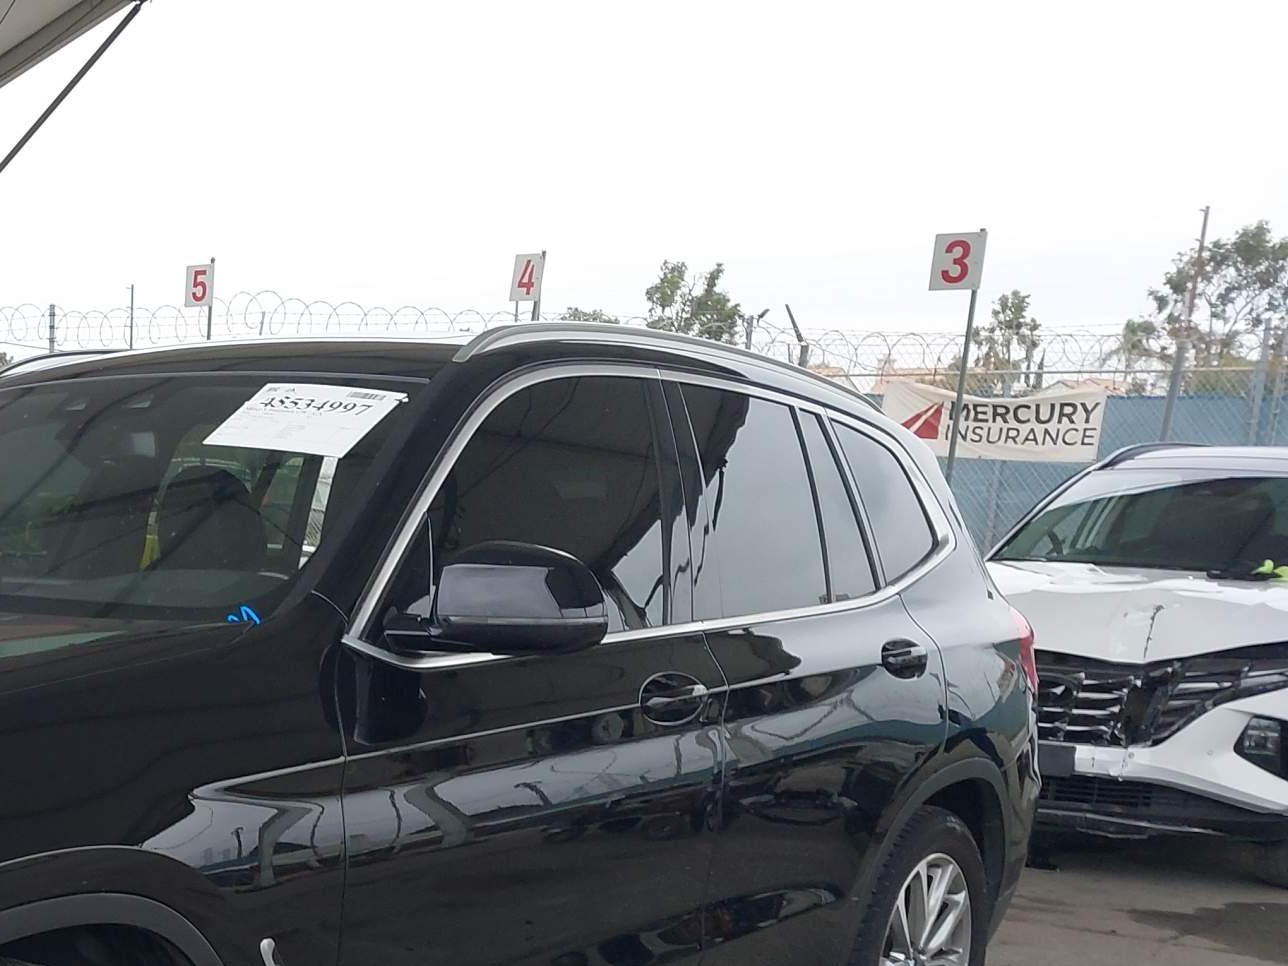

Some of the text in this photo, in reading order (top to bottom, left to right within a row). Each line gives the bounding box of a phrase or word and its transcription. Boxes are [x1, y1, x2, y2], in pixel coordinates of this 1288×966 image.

[941, 239, 971, 284] 3
[192, 269, 207, 302] 5
[517, 259, 535, 296] 4
[260, 396, 374, 416] 45534997
[948, 401, 1101, 424] MERCURY
[945, 423, 1098, 446] INSURANCE
